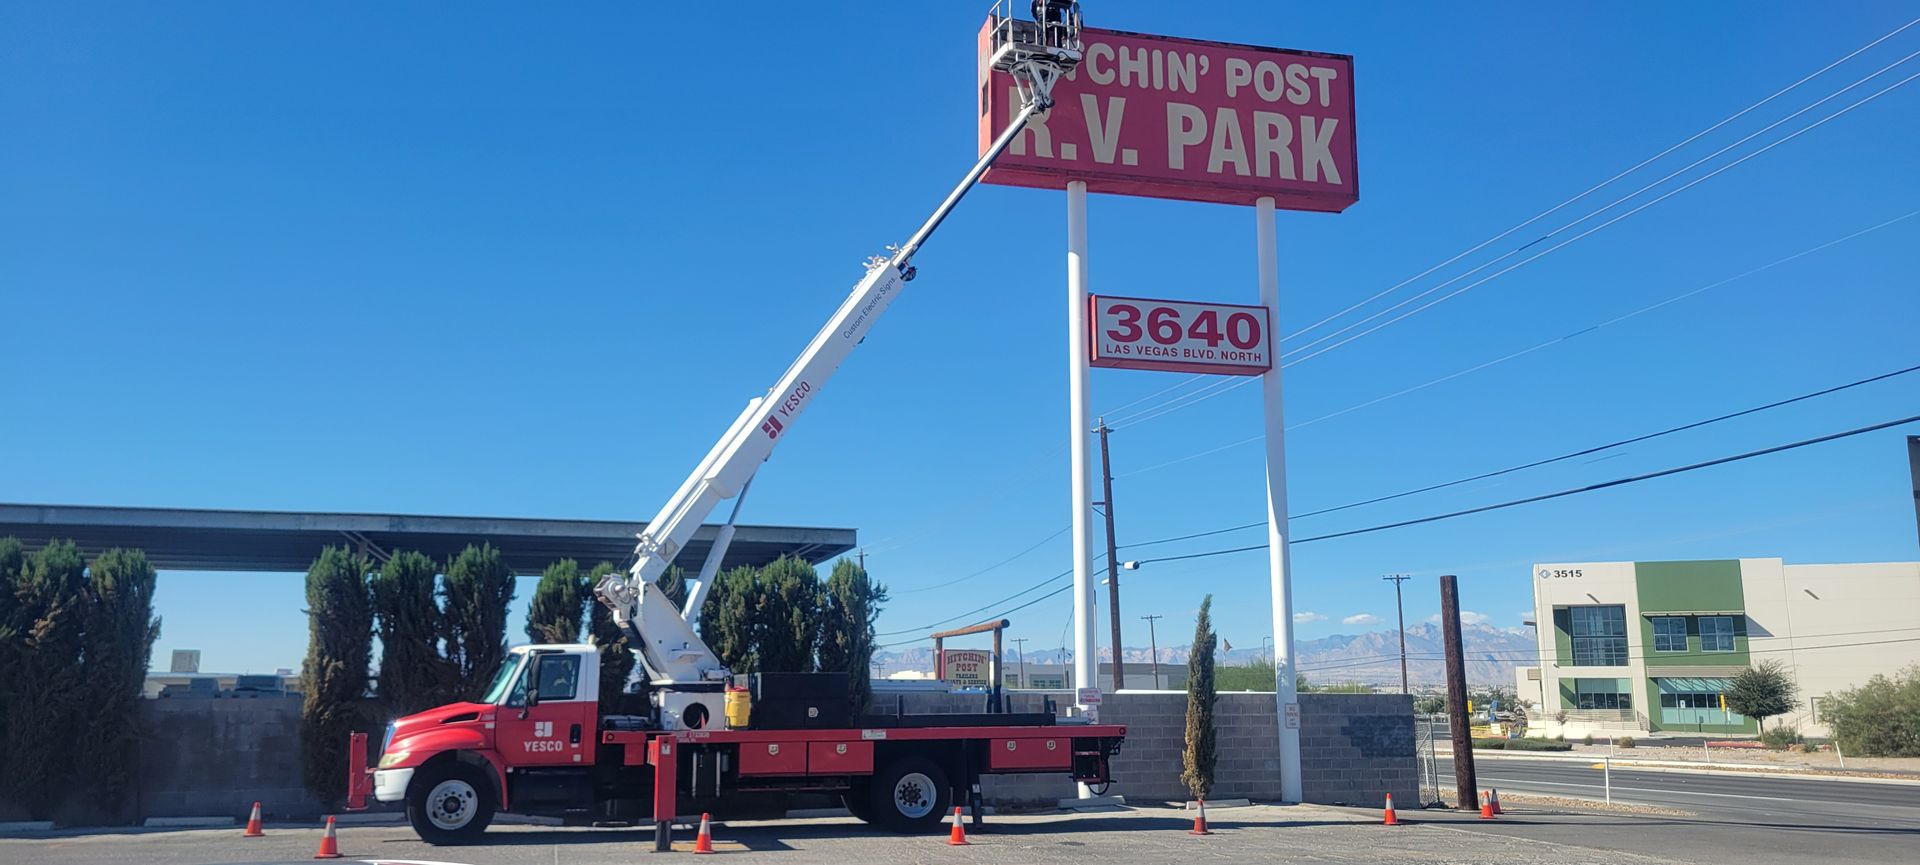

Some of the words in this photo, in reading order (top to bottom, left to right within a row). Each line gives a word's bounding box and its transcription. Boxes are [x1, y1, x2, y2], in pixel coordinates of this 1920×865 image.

[1066, 41, 1208, 94] CHIN'
[1226, 58, 1337, 107] POST
[1008, 86, 1139, 167] R.V.
[1167, 102, 1343, 186] PARK
[843, 314, 865, 339] Custom
[862, 293, 882, 317] Electric
[880, 277, 896, 295] Signs
[1106, 304, 1261, 350] 3640
[1106, 344, 1130, 354] LAS
[1136, 346, 1178, 357] VEGAS
[1183, 348, 1217, 360] BLVD.
[1221, 351, 1262, 362] NORTH
[779, 381, 810, 417] YESCO
[1553, 569, 1583, 578] 3515
[956, 663, 978, 672] POST
[523, 741, 563, 752] YESCO
